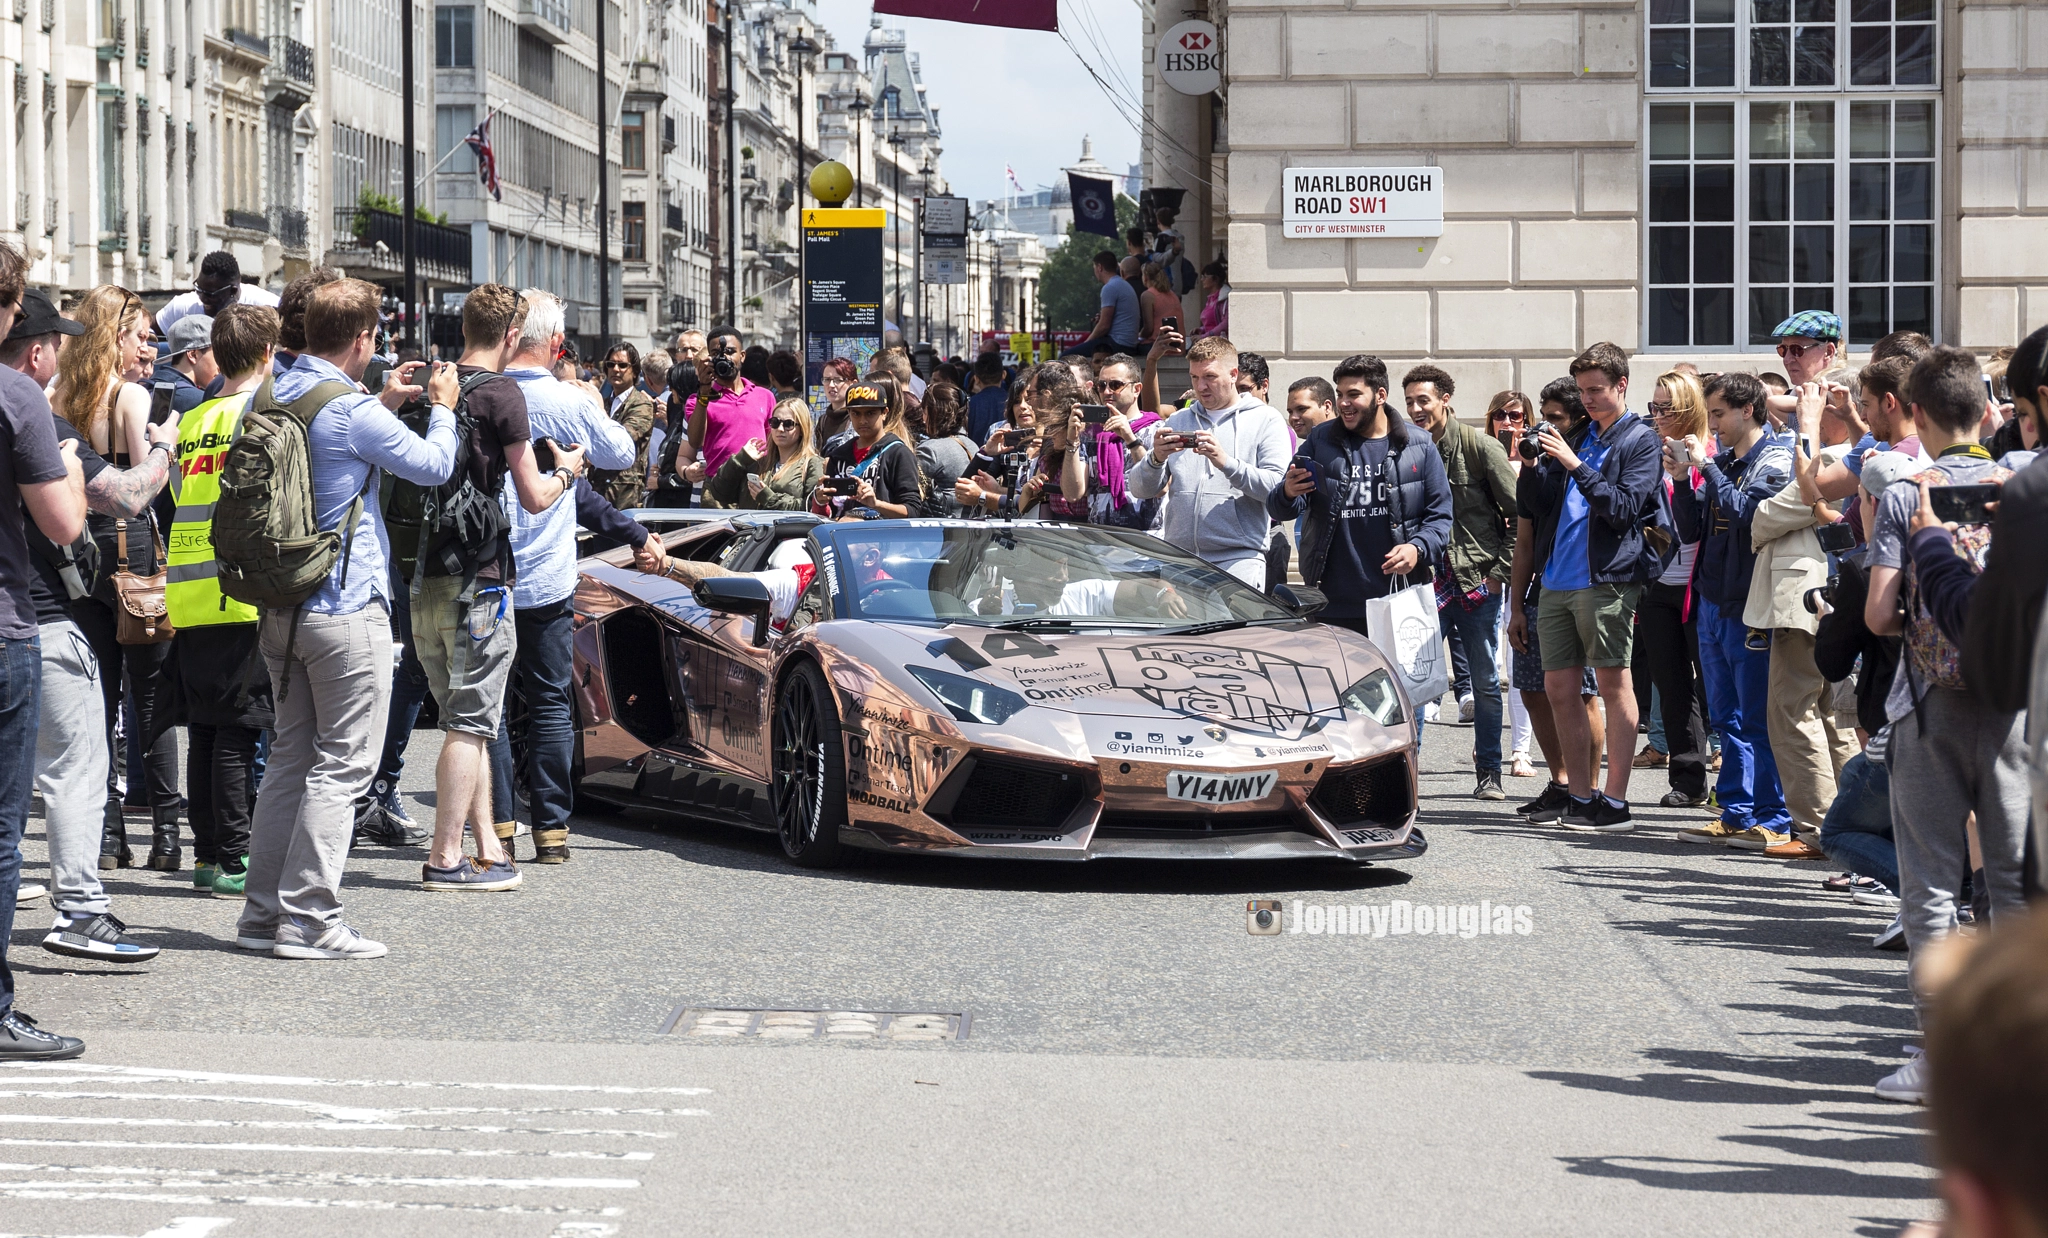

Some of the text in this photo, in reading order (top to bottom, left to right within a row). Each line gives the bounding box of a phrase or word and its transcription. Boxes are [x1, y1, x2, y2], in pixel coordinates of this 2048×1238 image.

[1295, 175, 1431, 193] MARLBOROUGH
[1295, 197, 1386, 214] ROAD SW1
[1295, 225, 1386, 233] CITY OF WESTMINSTER
[847, 386, 878, 404] BOOM
[1365, 464, 1371, 477] &
[909, 520, 1078, 530] MODBALL
[925, 632, 1060, 673] 14
[1136, 646, 1265, 673] mod
[1002, 661, 1088, 678] Yiannimize
[1038, 672, 1103, 684] SmarTrack
[1024, 682, 1114, 700] Ontime
[1097, 647, 1347, 721] ball
[846, 693, 910, 730] Yiannimize
[1157, 689, 1313, 740] rally
[722, 714, 762, 756] Ontime
[849, 736, 912, 771] Ontime
[1106, 741, 1204, 758] @yiannimize
[1266, 744, 1329, 756] @yiannimize1
[862, 774, 910, 795] SmarTrack
[849, 789, 910, 814] MODBALL
[1020, 834, 1063, 842] KING
